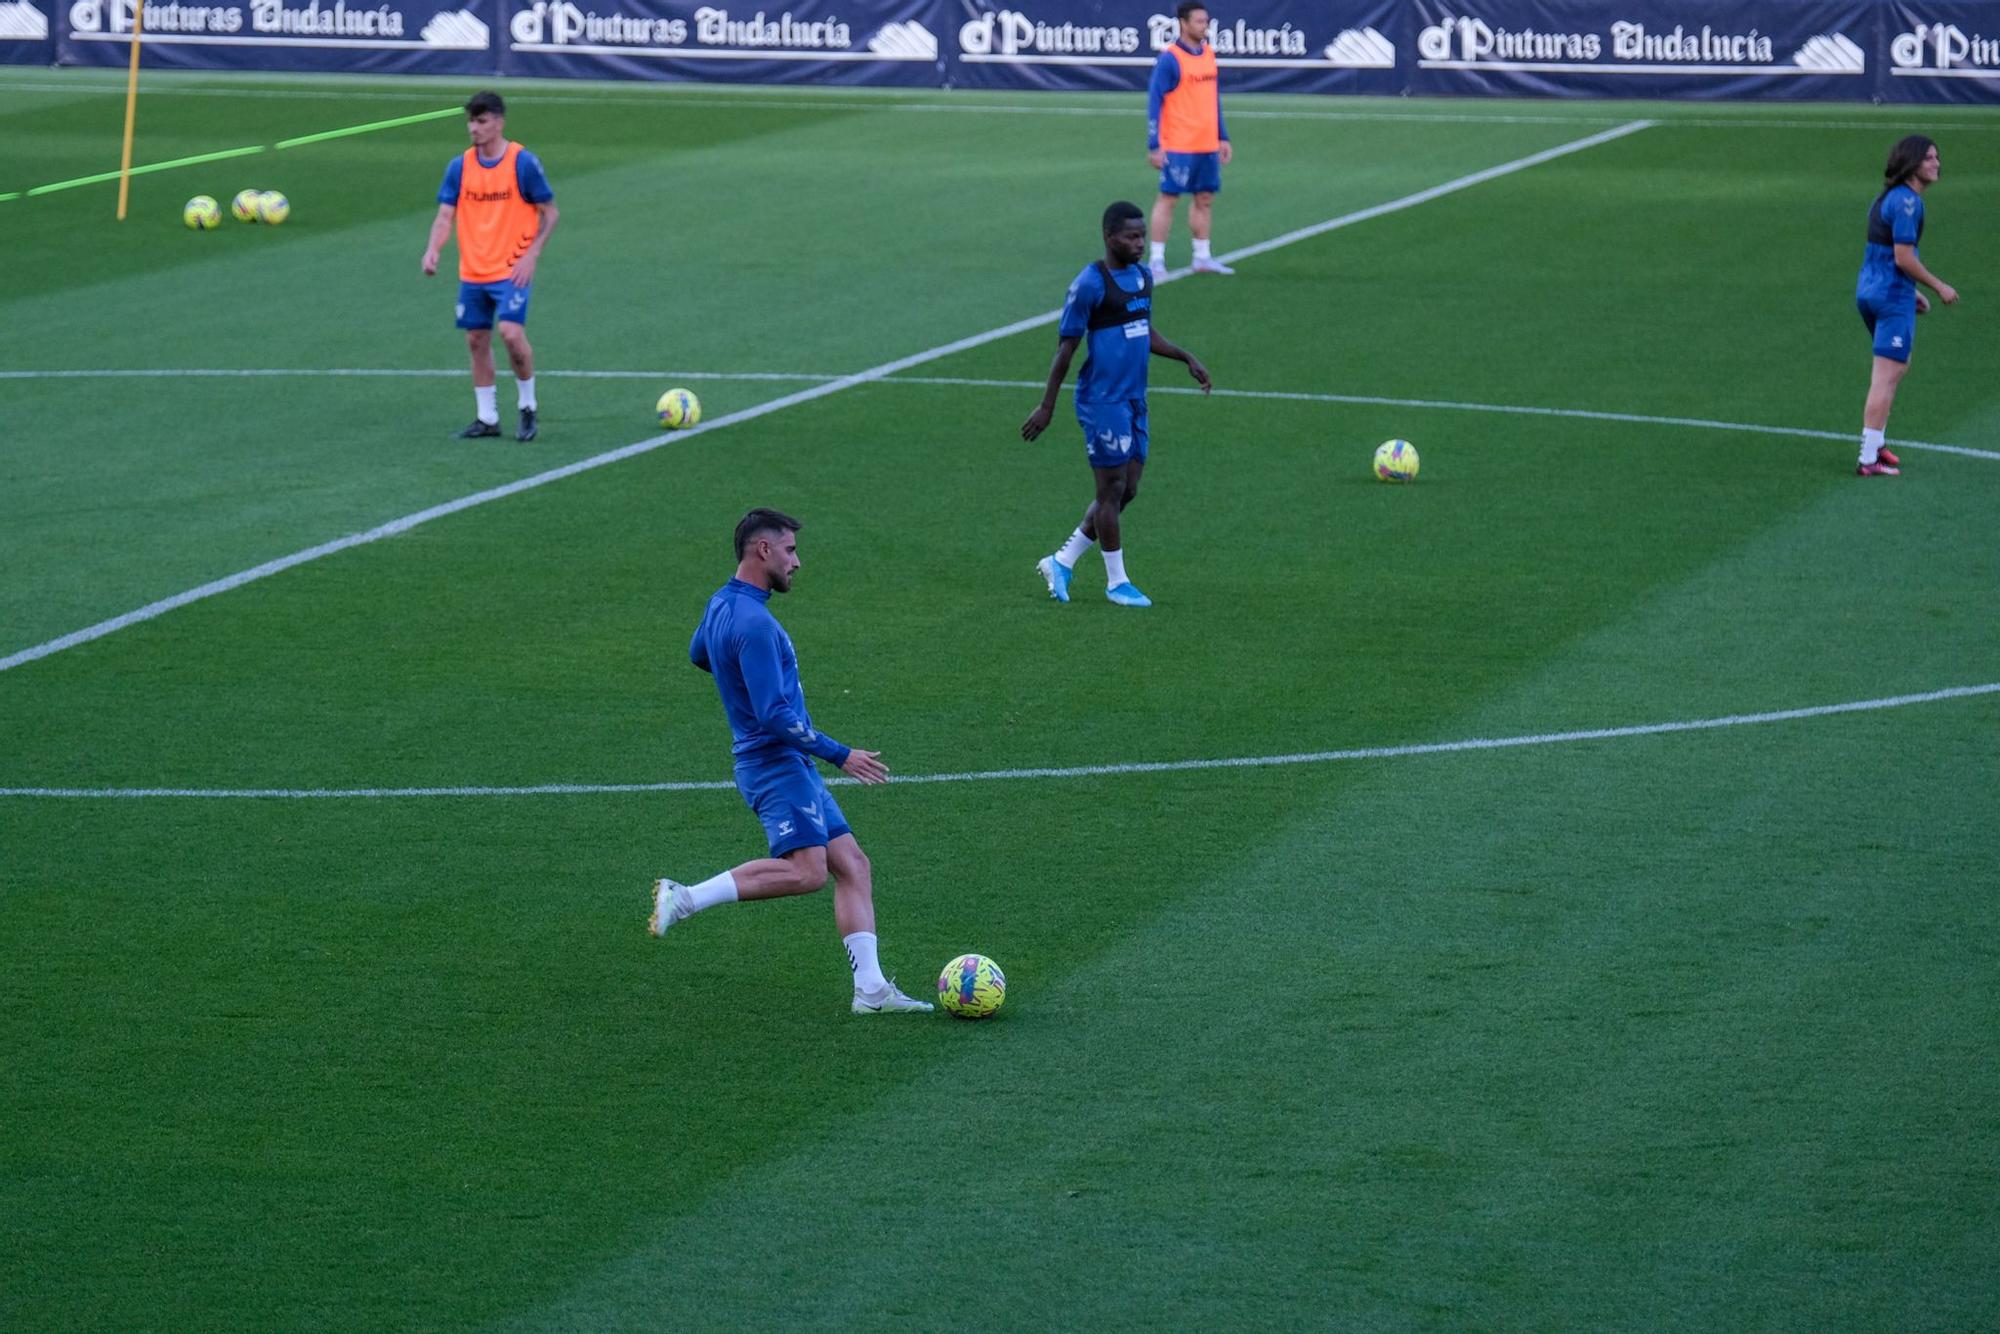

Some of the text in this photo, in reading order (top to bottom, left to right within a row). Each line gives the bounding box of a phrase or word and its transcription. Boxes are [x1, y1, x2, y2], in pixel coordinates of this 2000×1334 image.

[250, 0, 404, 37] Andalucía
[694, 6, 852, 48] Andalucía
[1147, 13, 1307, 56] Adalucía
[1611, 20, 1774, 62] Andalucía
